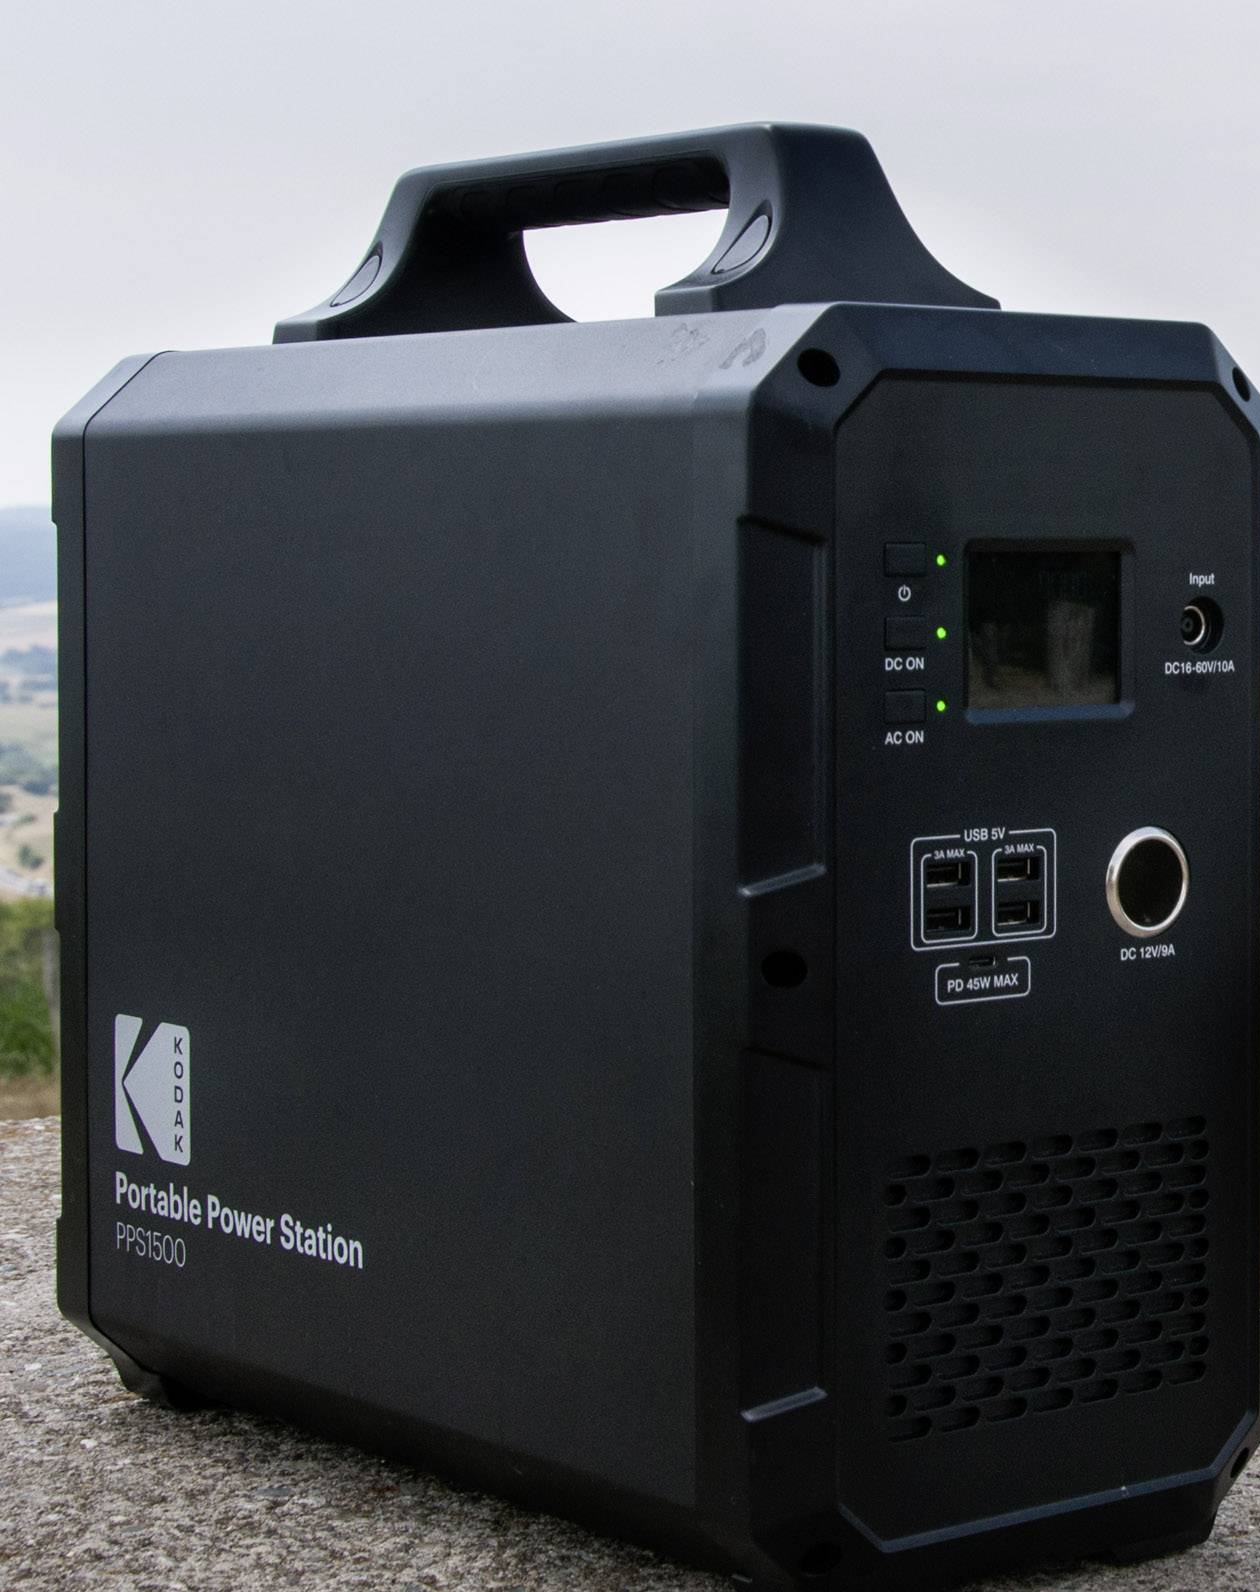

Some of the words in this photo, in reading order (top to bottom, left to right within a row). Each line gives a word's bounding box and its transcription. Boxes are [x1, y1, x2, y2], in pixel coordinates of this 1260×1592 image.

[1189, 572, 1215, 588] Input
[884, 657, 903, 671] DC
[905, 656, 925, 671] ON
[1164, 659, 1235, 675] DC16-60V/10A
[884, 731, 903, 745] AC
[905, 730, 924, 744] ON
[963, 828, 989, 842] USB
[991, 826, 1006, 841] 5V
[946, 848, 965, 859] MAX
[1016, 843, 1035, 854] MAX
[1120, 947, 1137, 961] DC
[1139, 943, 1176, 959] 12V/9A
[947, 978, 964, 993] PD
[966, 976, 991, 991] 45W
[993, 973, 1019, 988] MAX
[173, 1036, 185, 1154] KODAK
[115, 1170, 202, 1226] Portable
[207, 1194, 275, 1245] Power
[279, 1213, 364, 1270] Station
[116, 1221, 187, 1268] PPS1500
